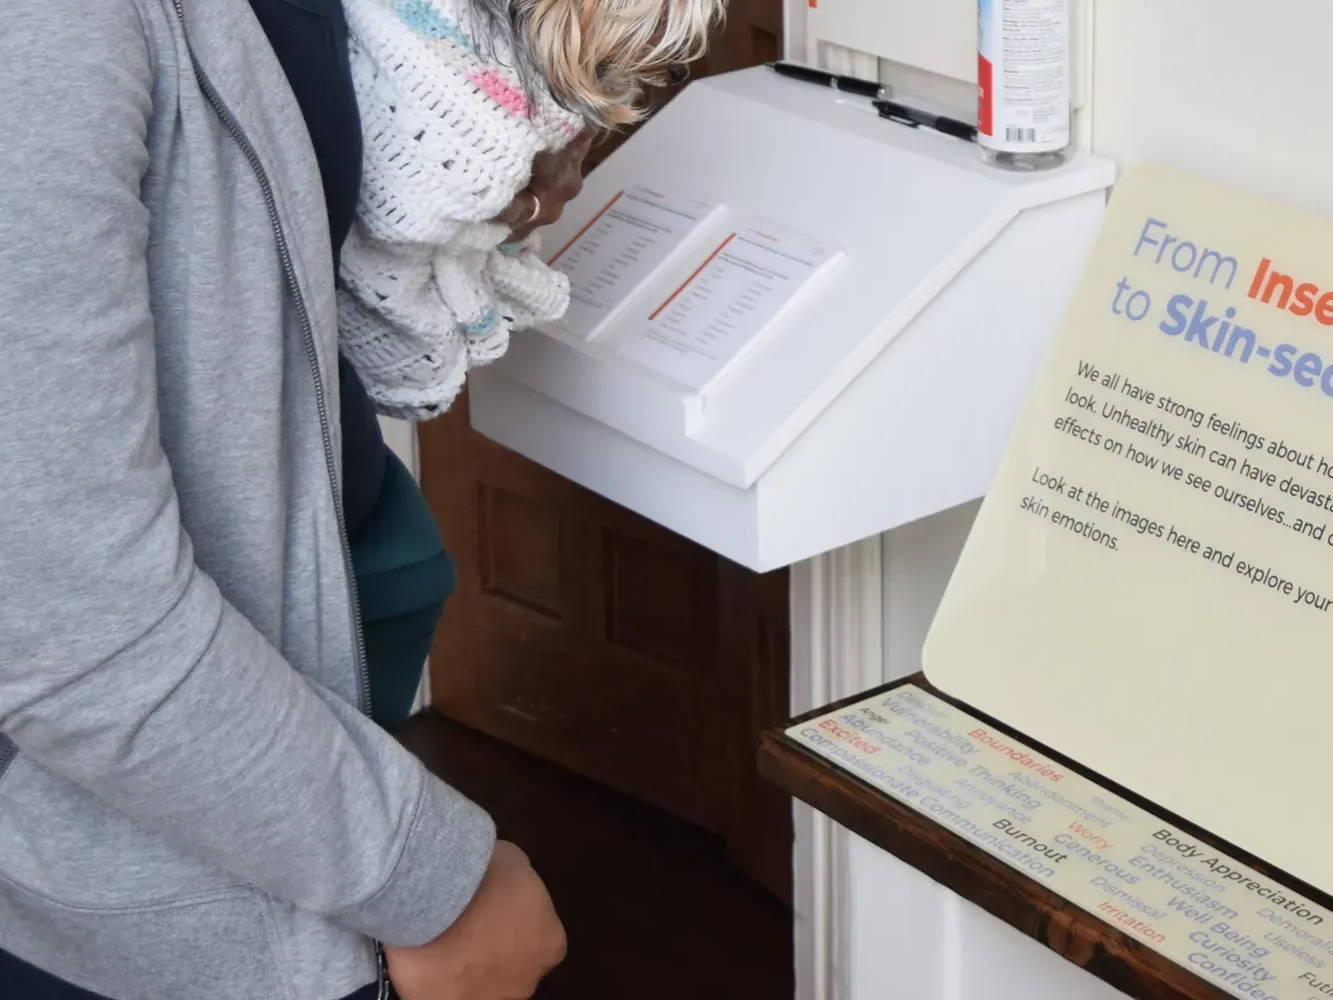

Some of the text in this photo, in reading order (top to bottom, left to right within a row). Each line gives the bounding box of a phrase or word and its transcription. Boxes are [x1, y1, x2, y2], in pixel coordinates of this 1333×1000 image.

[1133, 217, 1239, 290] From
[1111, 276, 1151, 321] to
[1064, 386, 1097, 414] look.
[1101, 401, 1175, 447] Unhealthy
[1175, 435, 1206, 459] skin
[1208, 450, 1238, 472] can
[1239, 458, 1277, 487] have
[1077, 360, 1100, 382] We
[1101, 373, 1120, 390] all
[1121, 378, 1155, 405] have
[1157, 396, 1205, 428] strong
[1206, 413, 1266, 450] feelings
[1267, 440, 1315, 470] about
[1054, 416, 1103, 447] effects
[1104, 438, 1123, 455] on
[1125, 443, 1159, 470] how
[1161, 461, 1184, 481] we
[1185, 472, 1212, 493] see
[1020, 495, 1120, 551] skin emotions.
[1032, 466, 1333, 612] Look at the images here and explore your
[818, 719, 882, 754] Excited
[839, 713, 931, 766] Abundance
[858, 706, 891, 726] Anger
[881, 697, 981, 755] Vulnerability
[904, 729, 1043, 810] Positive Thinking
[968, 727, 1064, 783] Boundaries
[800, 727, 1056, 878] Compassionate Communication
[954, 777, 1032, 824] Annoyance
[1008, 770, 1112, 829] Abandonment
[992, 817, 1069, 864] Burnout
[1053, 832, 1140, 885] Generous
[1068, 821, 1118, 850] Worry
[1128, 855, 1239, 920] Enthusiasm
[1141, 843, 1226, 893] Depression
[1152, 828, 1325, 926] Body Appreciation
[1090, 876, 1168, 920] Dismissal
[1097, 901, 1167, 944] Irritation
[1166, 896, 1270, 960] Well Being
[1188, 930, 1278, 982] Curiosity
[1263, 931, 1326, 969] Useless
